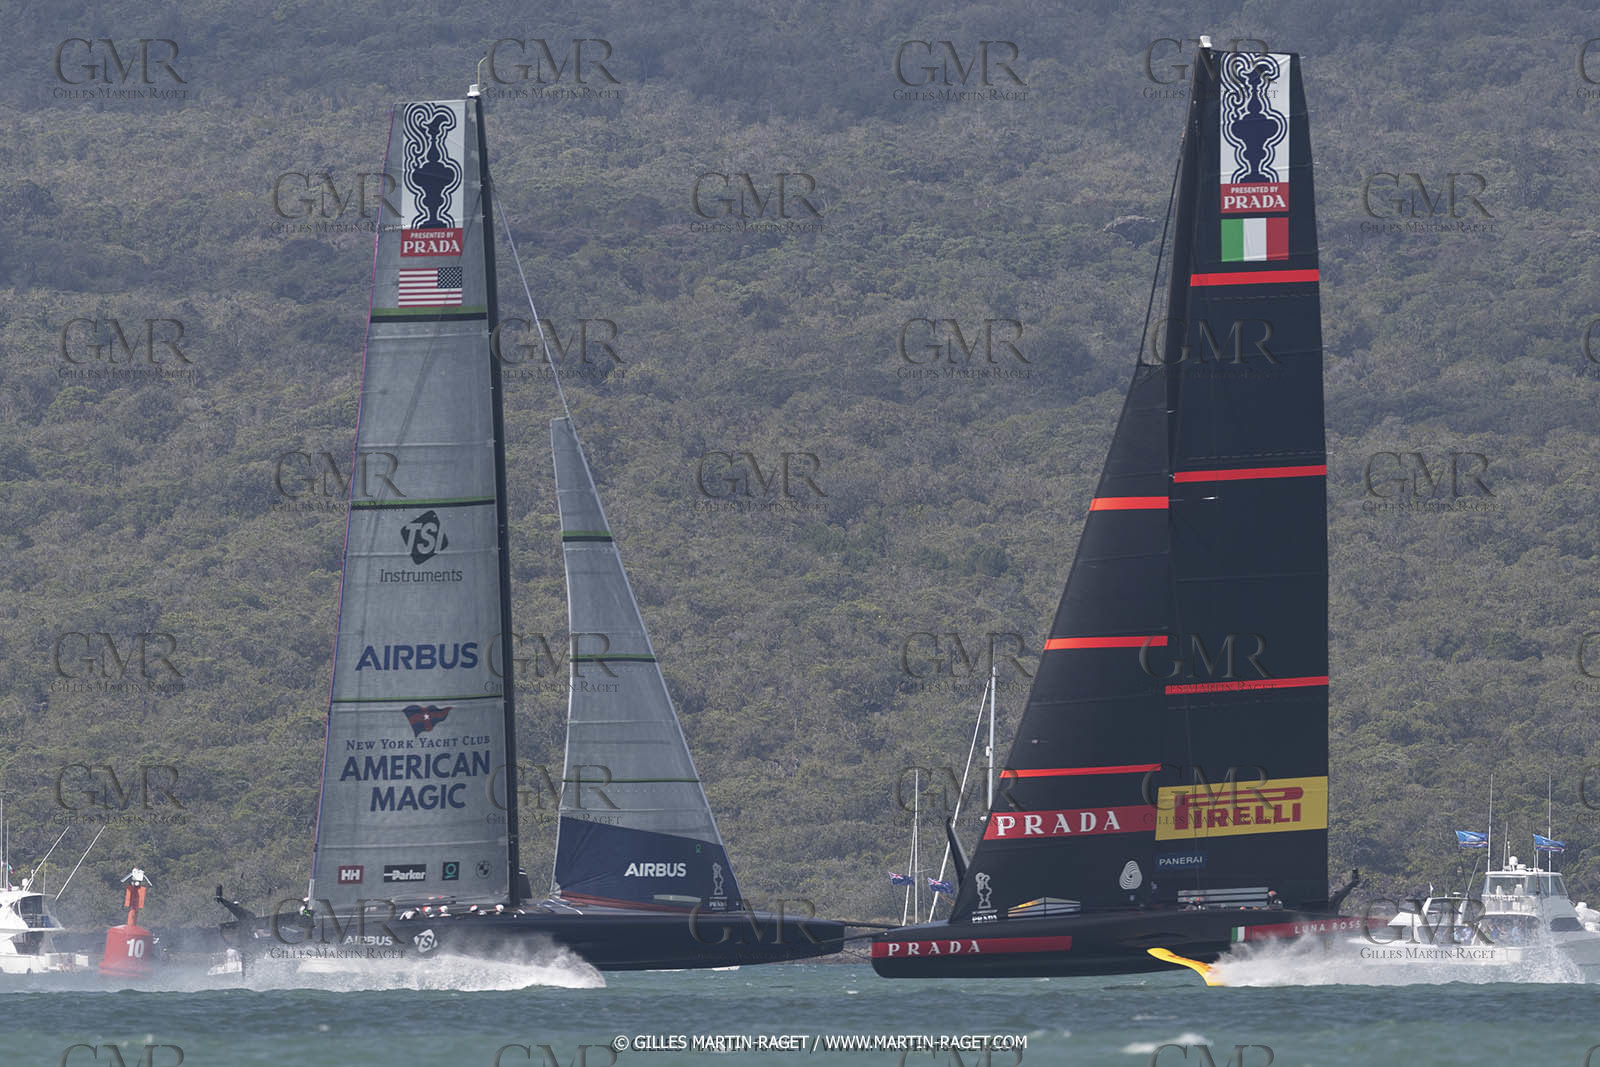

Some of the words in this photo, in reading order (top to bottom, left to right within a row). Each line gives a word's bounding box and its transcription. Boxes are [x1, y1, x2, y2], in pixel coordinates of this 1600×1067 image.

[1223, 194, 1286, 209] PRADA
[410, 231, 445, 239] PRESENTED
[403, 240, 460, 253] PRADA
[402, 520, 447, 555] TSI
[380, 568, 463, 582] Instruments
[355, 642, 479, 671] AIRBUS
[346, 739, 375, 751] NEW
[381, 738, 414, 750] YORK
[419, 737, 459, 749] YACHT
[462, 735, 491, 746] CLUB
[339, 750, 491, 782] AMERICAN
[370, 783, 467, 812] MAGIC
[1174, 786, 1304, 830] PIRELLI
[996, 810, 1121, 836] PRADA
[1159, 855, 1203, 866] PANERAI
[341, 869, 360, 881] HH
[391, 869, 426, 881] Parker
[624, 862, 687, 877] AIRBUS
[1294, 923, 1325, 934] LUNA
[127, 938, 145, 957] 10
[344, 935, 393, 946] AIRBUS
[888, 940, 980, 956] PRADA
